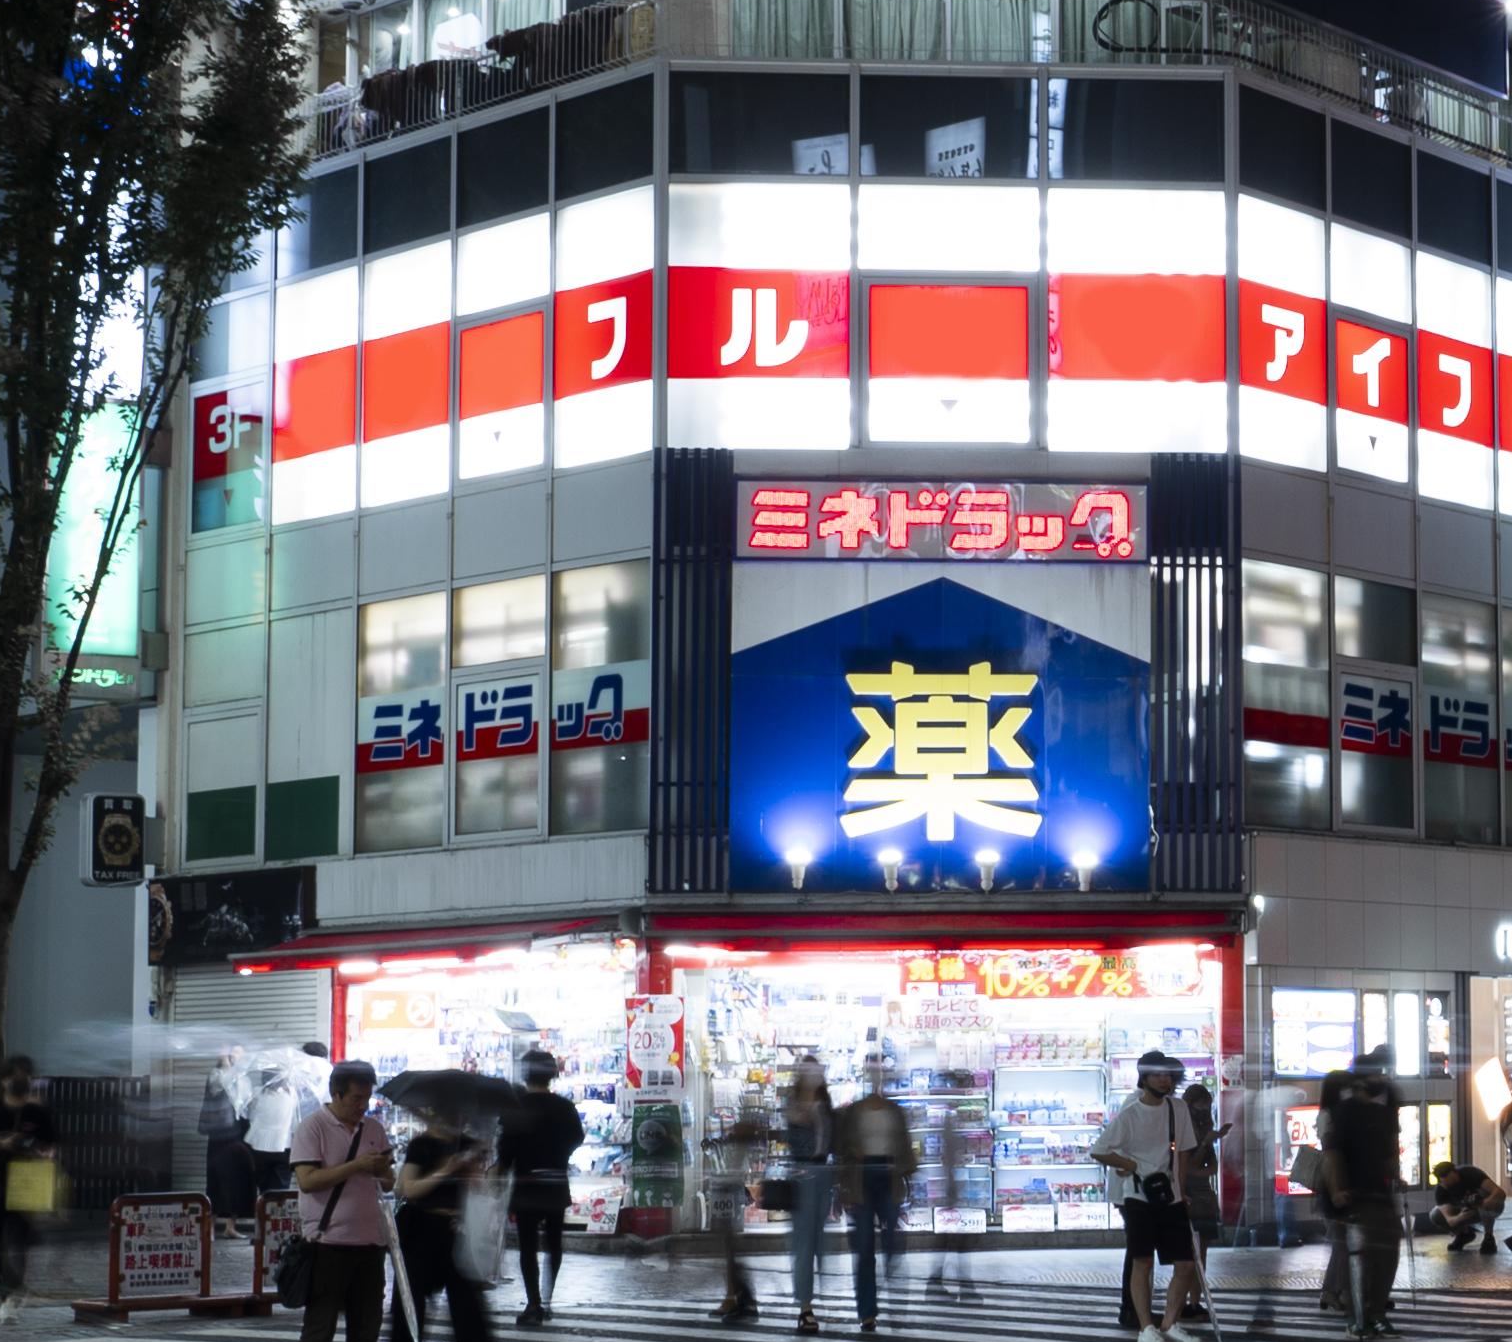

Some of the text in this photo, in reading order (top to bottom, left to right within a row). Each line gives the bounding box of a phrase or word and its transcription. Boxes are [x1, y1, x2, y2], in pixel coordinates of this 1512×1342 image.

[208, 403, 252, 455] 3F
[369, 672, 625, 761] ミネドラッグ
[840, 661, 1043, 841] 薬
[103, 797, 134, 811] 買取
[94, 869, 115, 881] TAX
[920, 998, 979, 1015] テレビで
[124, 1252, 196, 1271] 路上喫煙禁止
